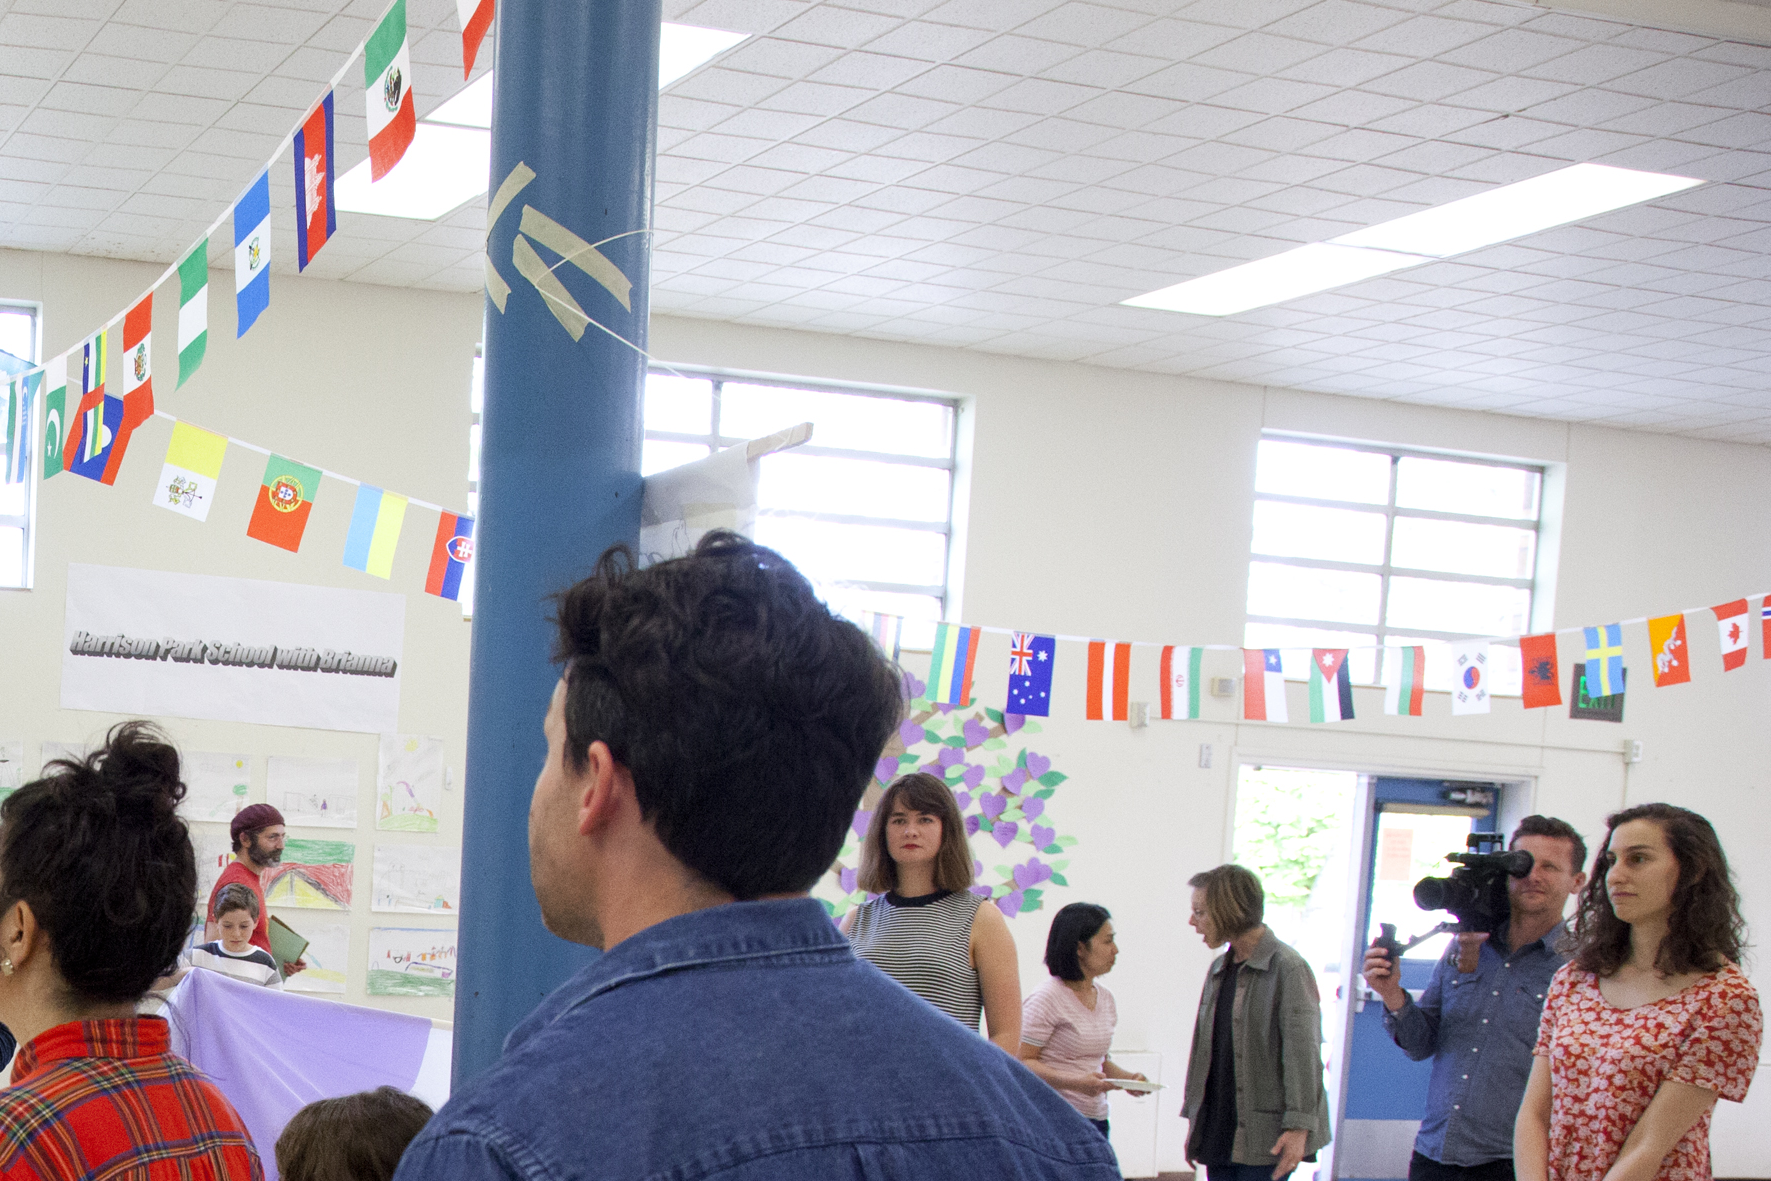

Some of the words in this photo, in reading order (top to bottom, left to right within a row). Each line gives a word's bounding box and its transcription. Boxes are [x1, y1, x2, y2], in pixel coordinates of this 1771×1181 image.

[69, 629, 162, 658] Harrison
[159, 636, 209, 664] Park
[206, 640, 278, 670] School
[276, 647, 322, 673] with
[318, 649, 398, 679] Brianna
